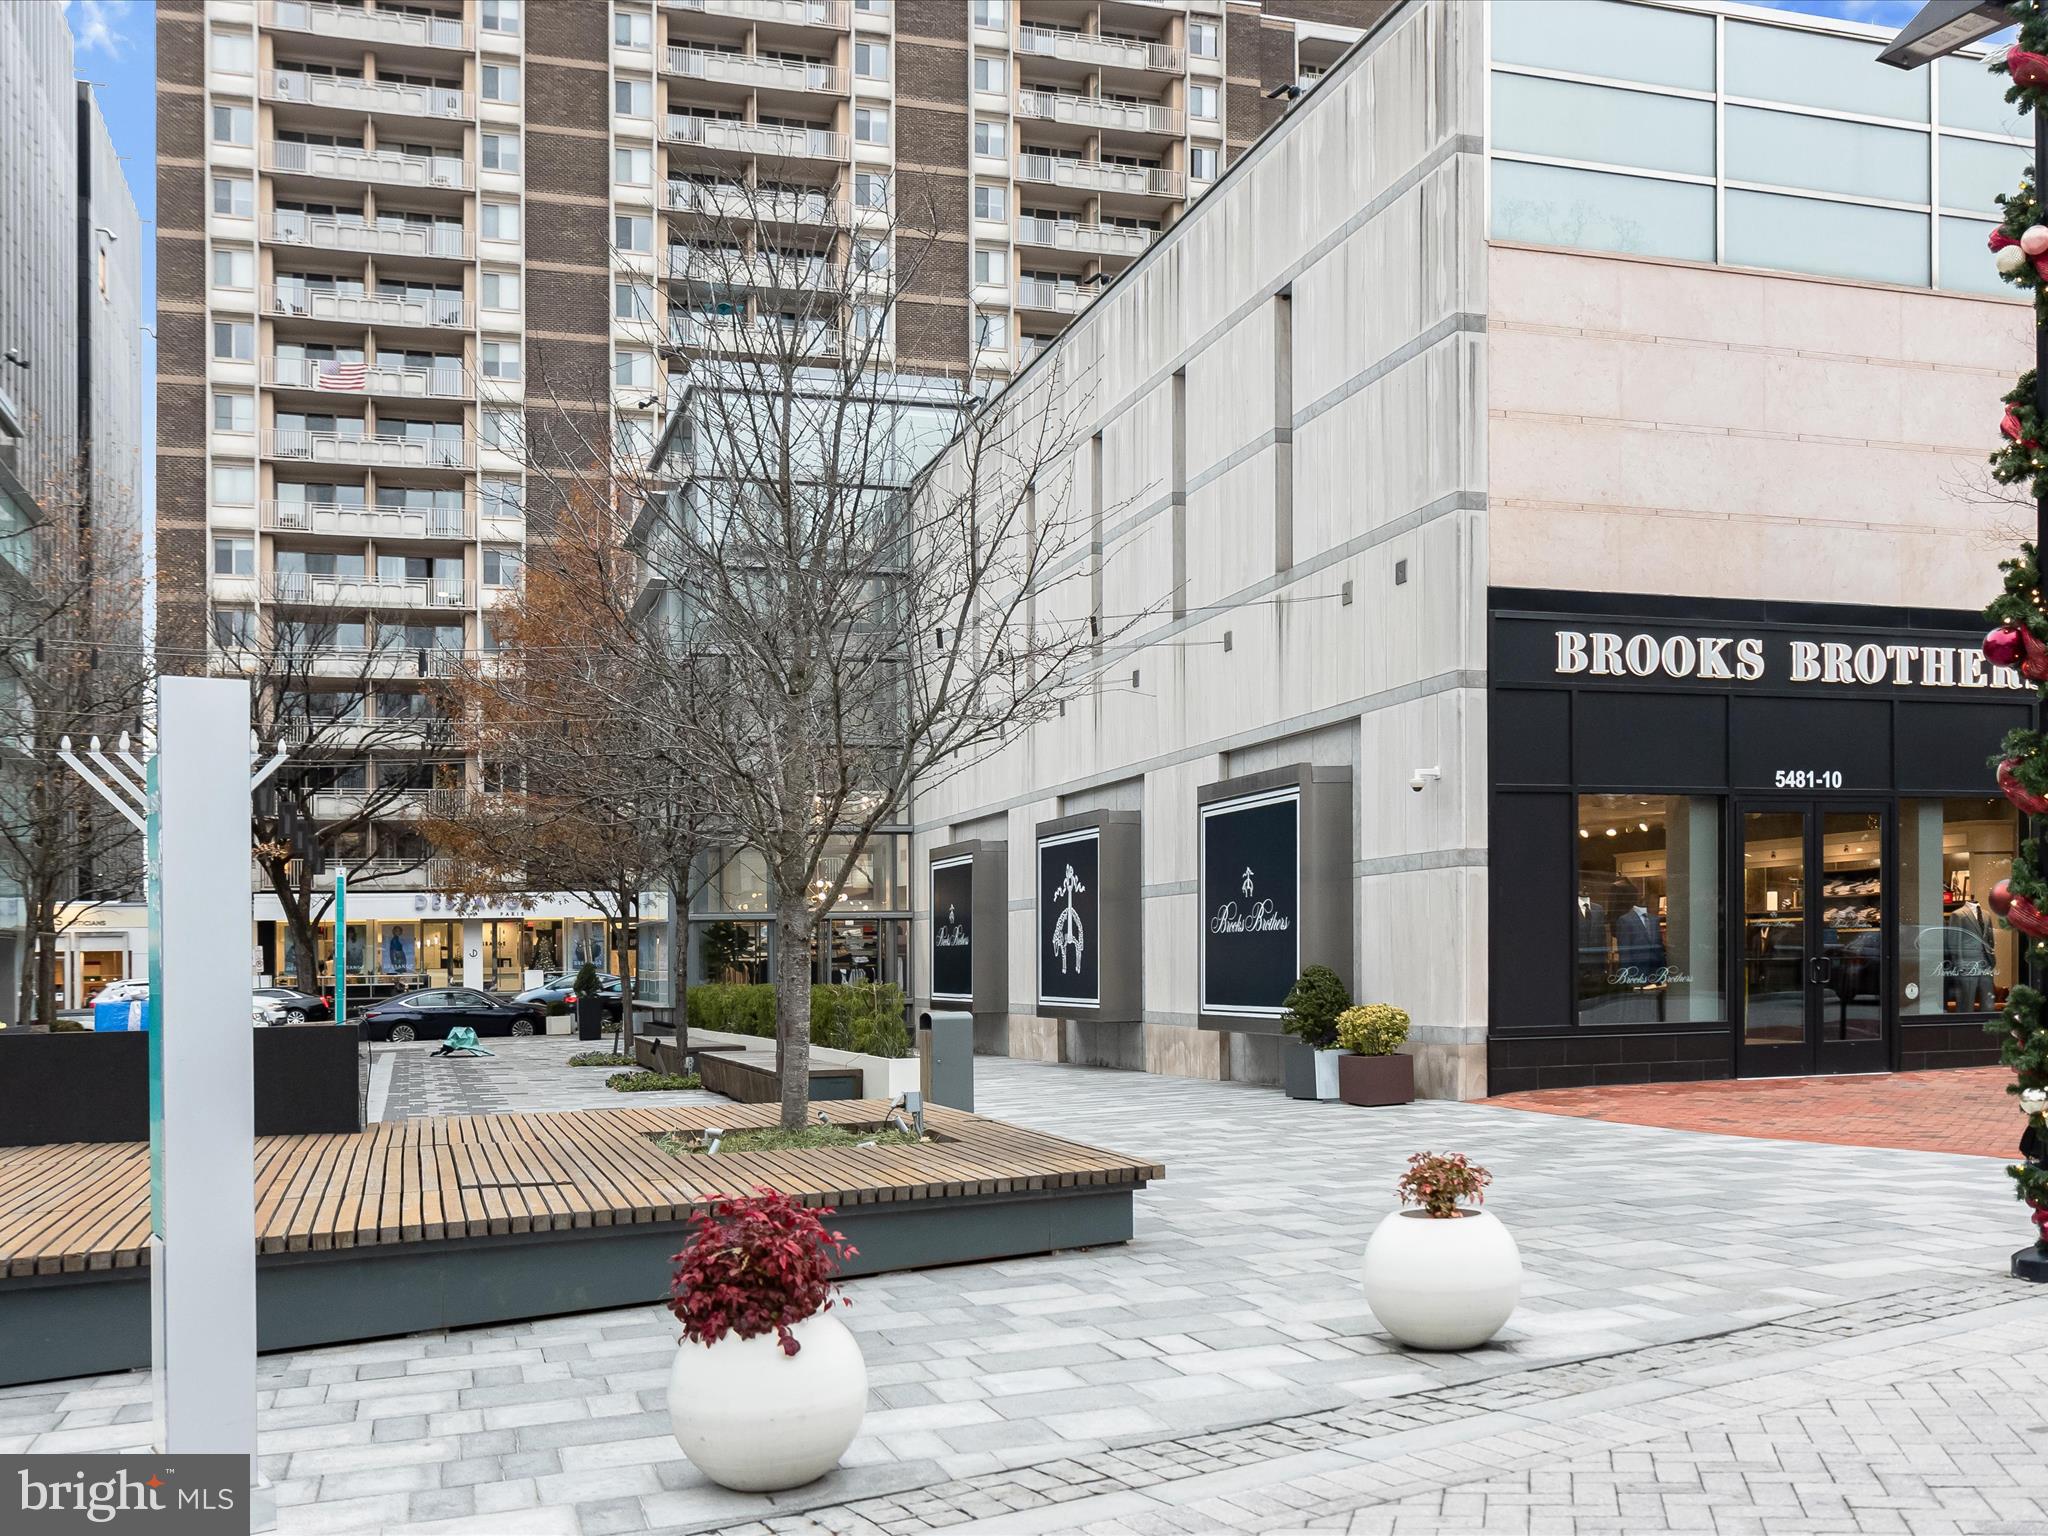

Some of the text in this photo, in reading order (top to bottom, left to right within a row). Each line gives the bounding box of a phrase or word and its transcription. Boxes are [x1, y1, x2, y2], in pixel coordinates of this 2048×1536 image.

[1555, 630, 2039, 691] BROOKS BROTHER
[1775, 770, 1842, 789] 5481-10
[1210, 898, 1290, 934] Brooks Brothers
